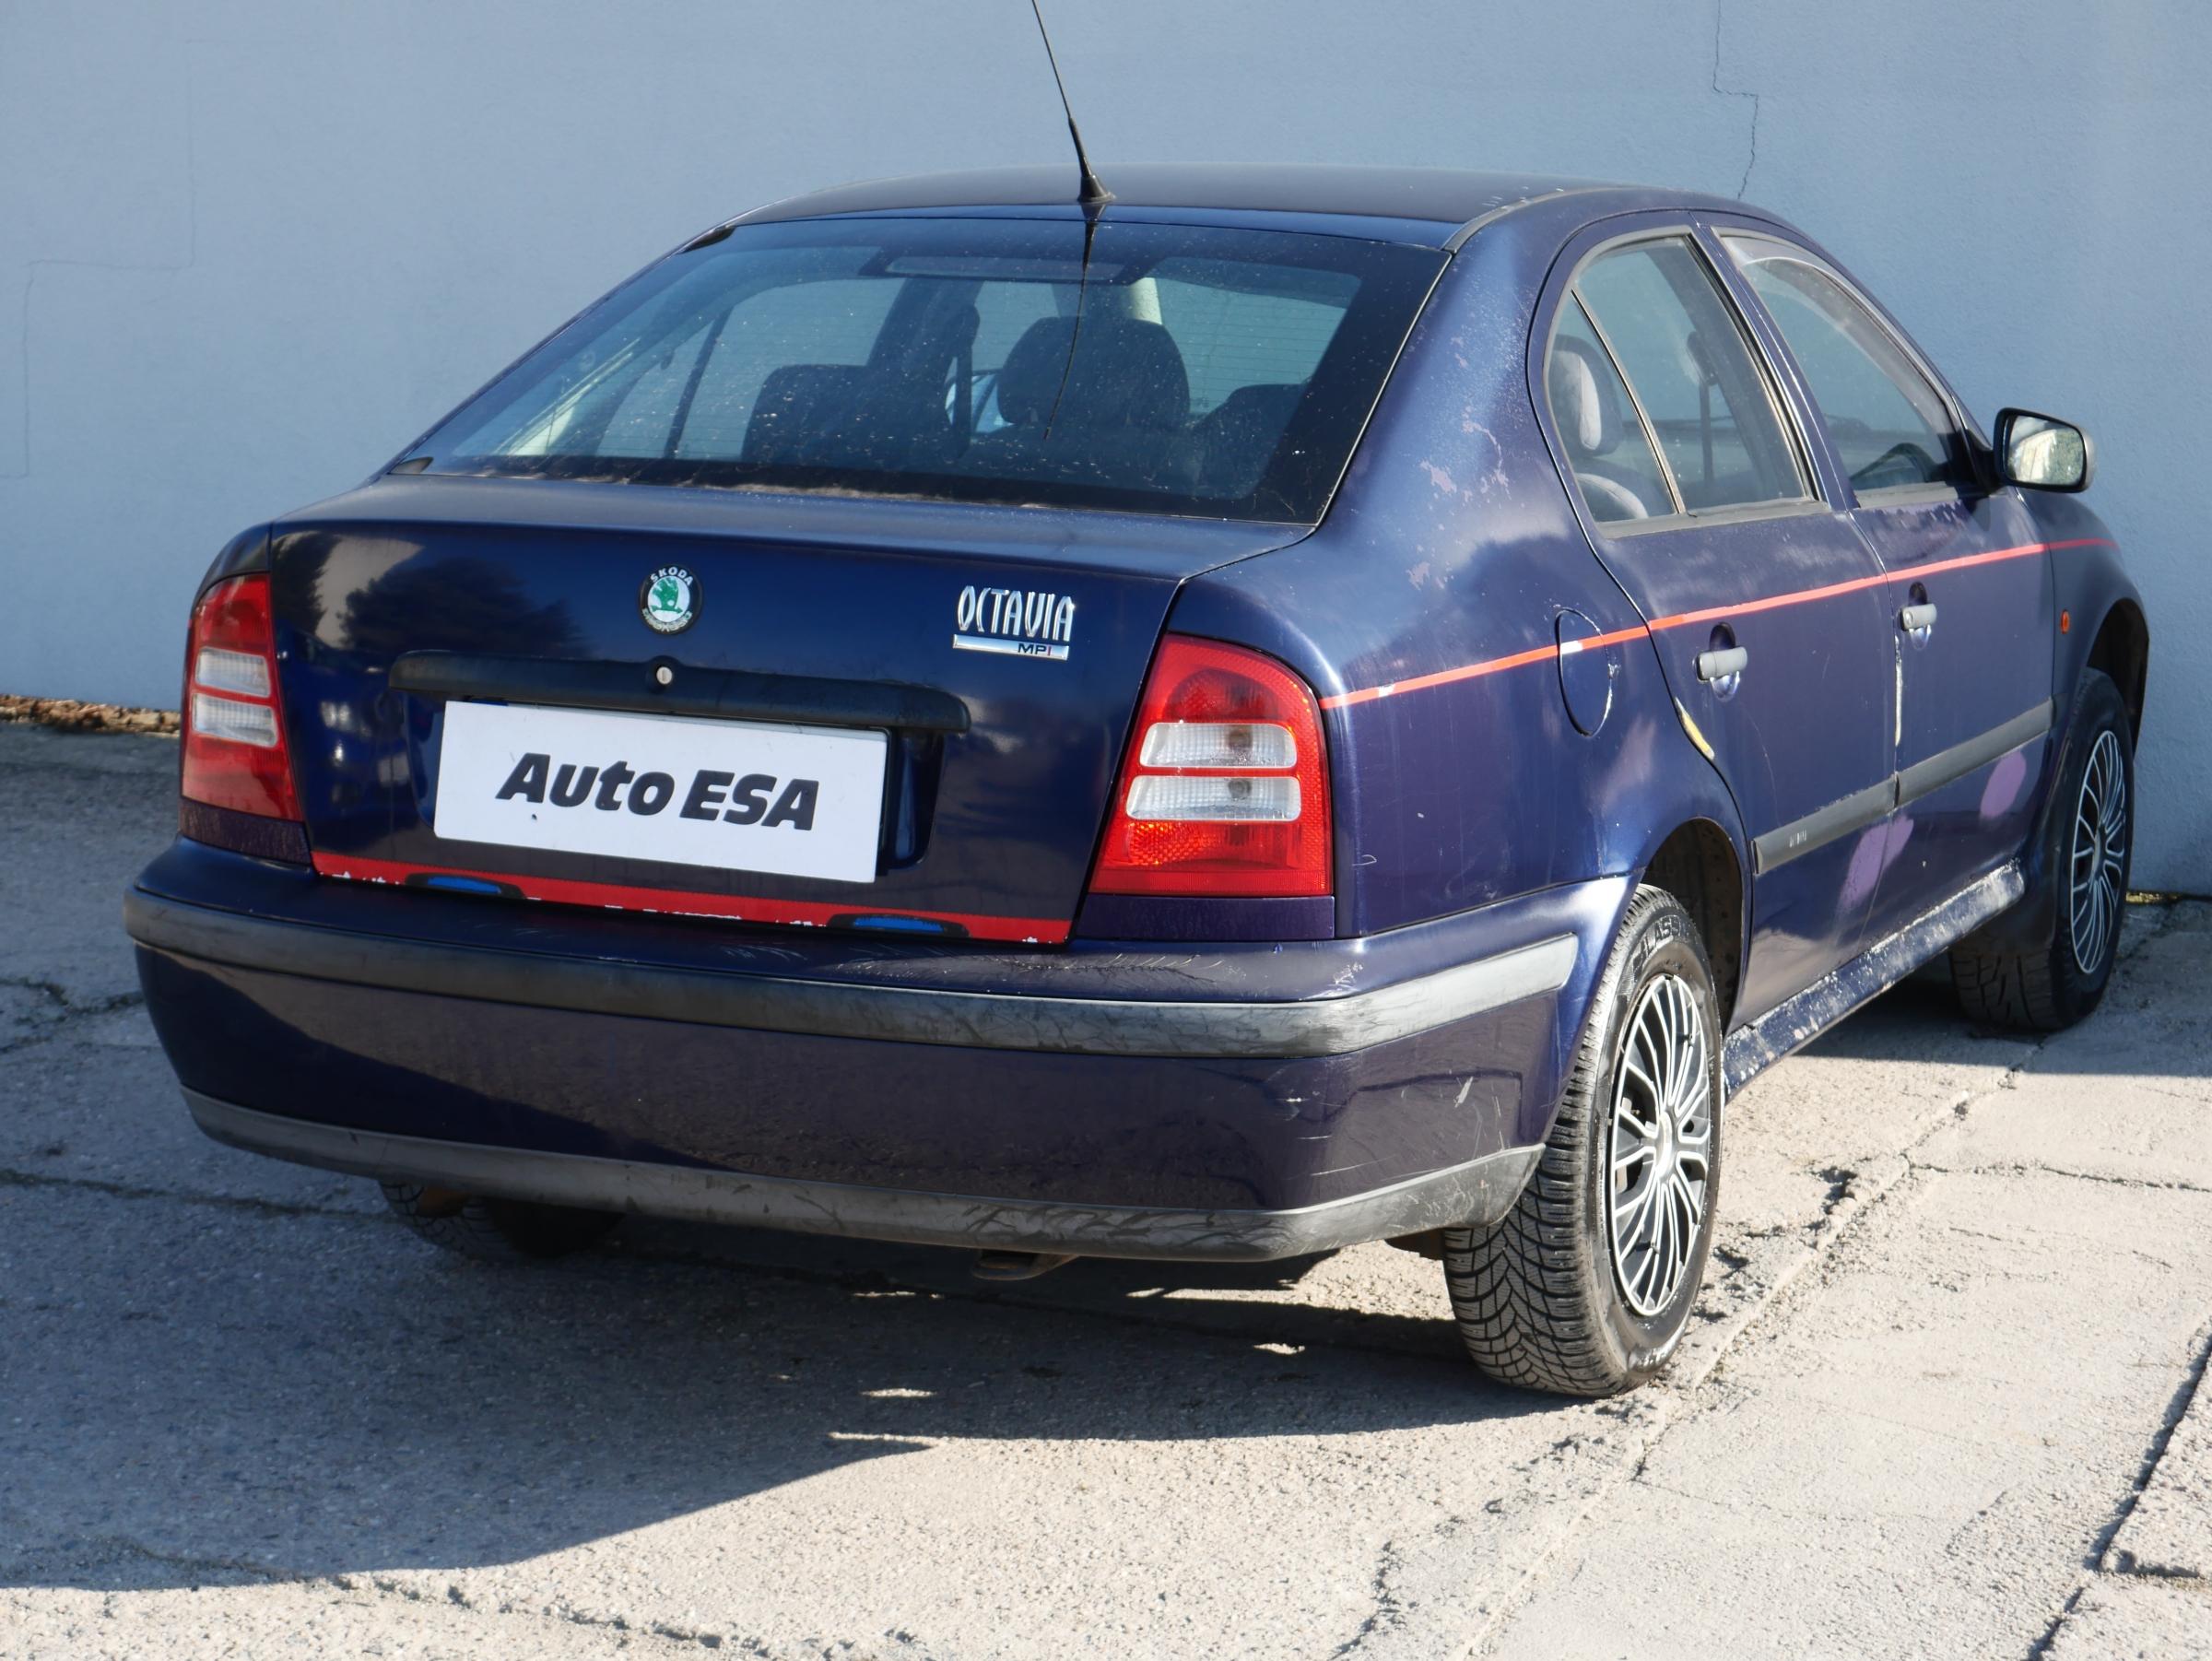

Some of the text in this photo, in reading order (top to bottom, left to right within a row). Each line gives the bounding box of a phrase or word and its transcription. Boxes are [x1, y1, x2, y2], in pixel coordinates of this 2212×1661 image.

[958, 585, 1074, 642] OCTAVIA
[1018, 642, 1053, 656] MPI
[495, 752, 819, 830] Auto ESA
